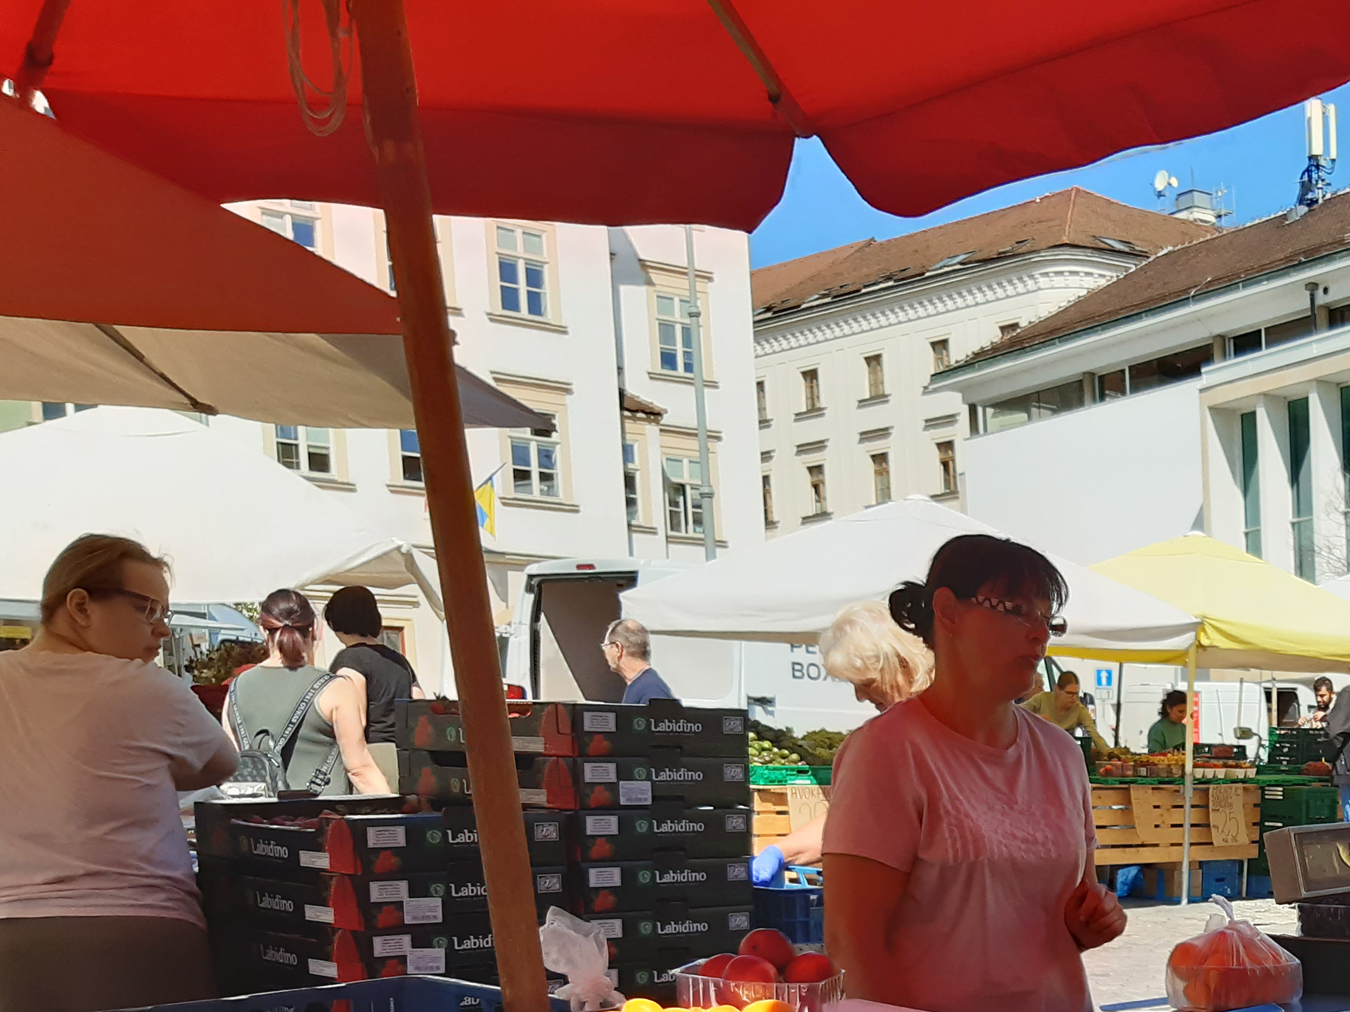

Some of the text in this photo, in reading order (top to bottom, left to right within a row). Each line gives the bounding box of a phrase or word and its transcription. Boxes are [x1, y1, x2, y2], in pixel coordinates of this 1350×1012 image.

[650, 718, 703, 733] Labidino
[651, 768, 704, 782] Labidino
[652, 819, 705, 833] Labidino
[446, 828, 479, 845] Labi
[250, 837, 289, 859] Labidino
[655, 870, 708, 883] Labidino
[256, 890, 294, 912] Labidino
[656, 921, 709, 935] Labidino
[452, 934, 494, 951] Labid
[260, 943, 298, 965] Labidino
